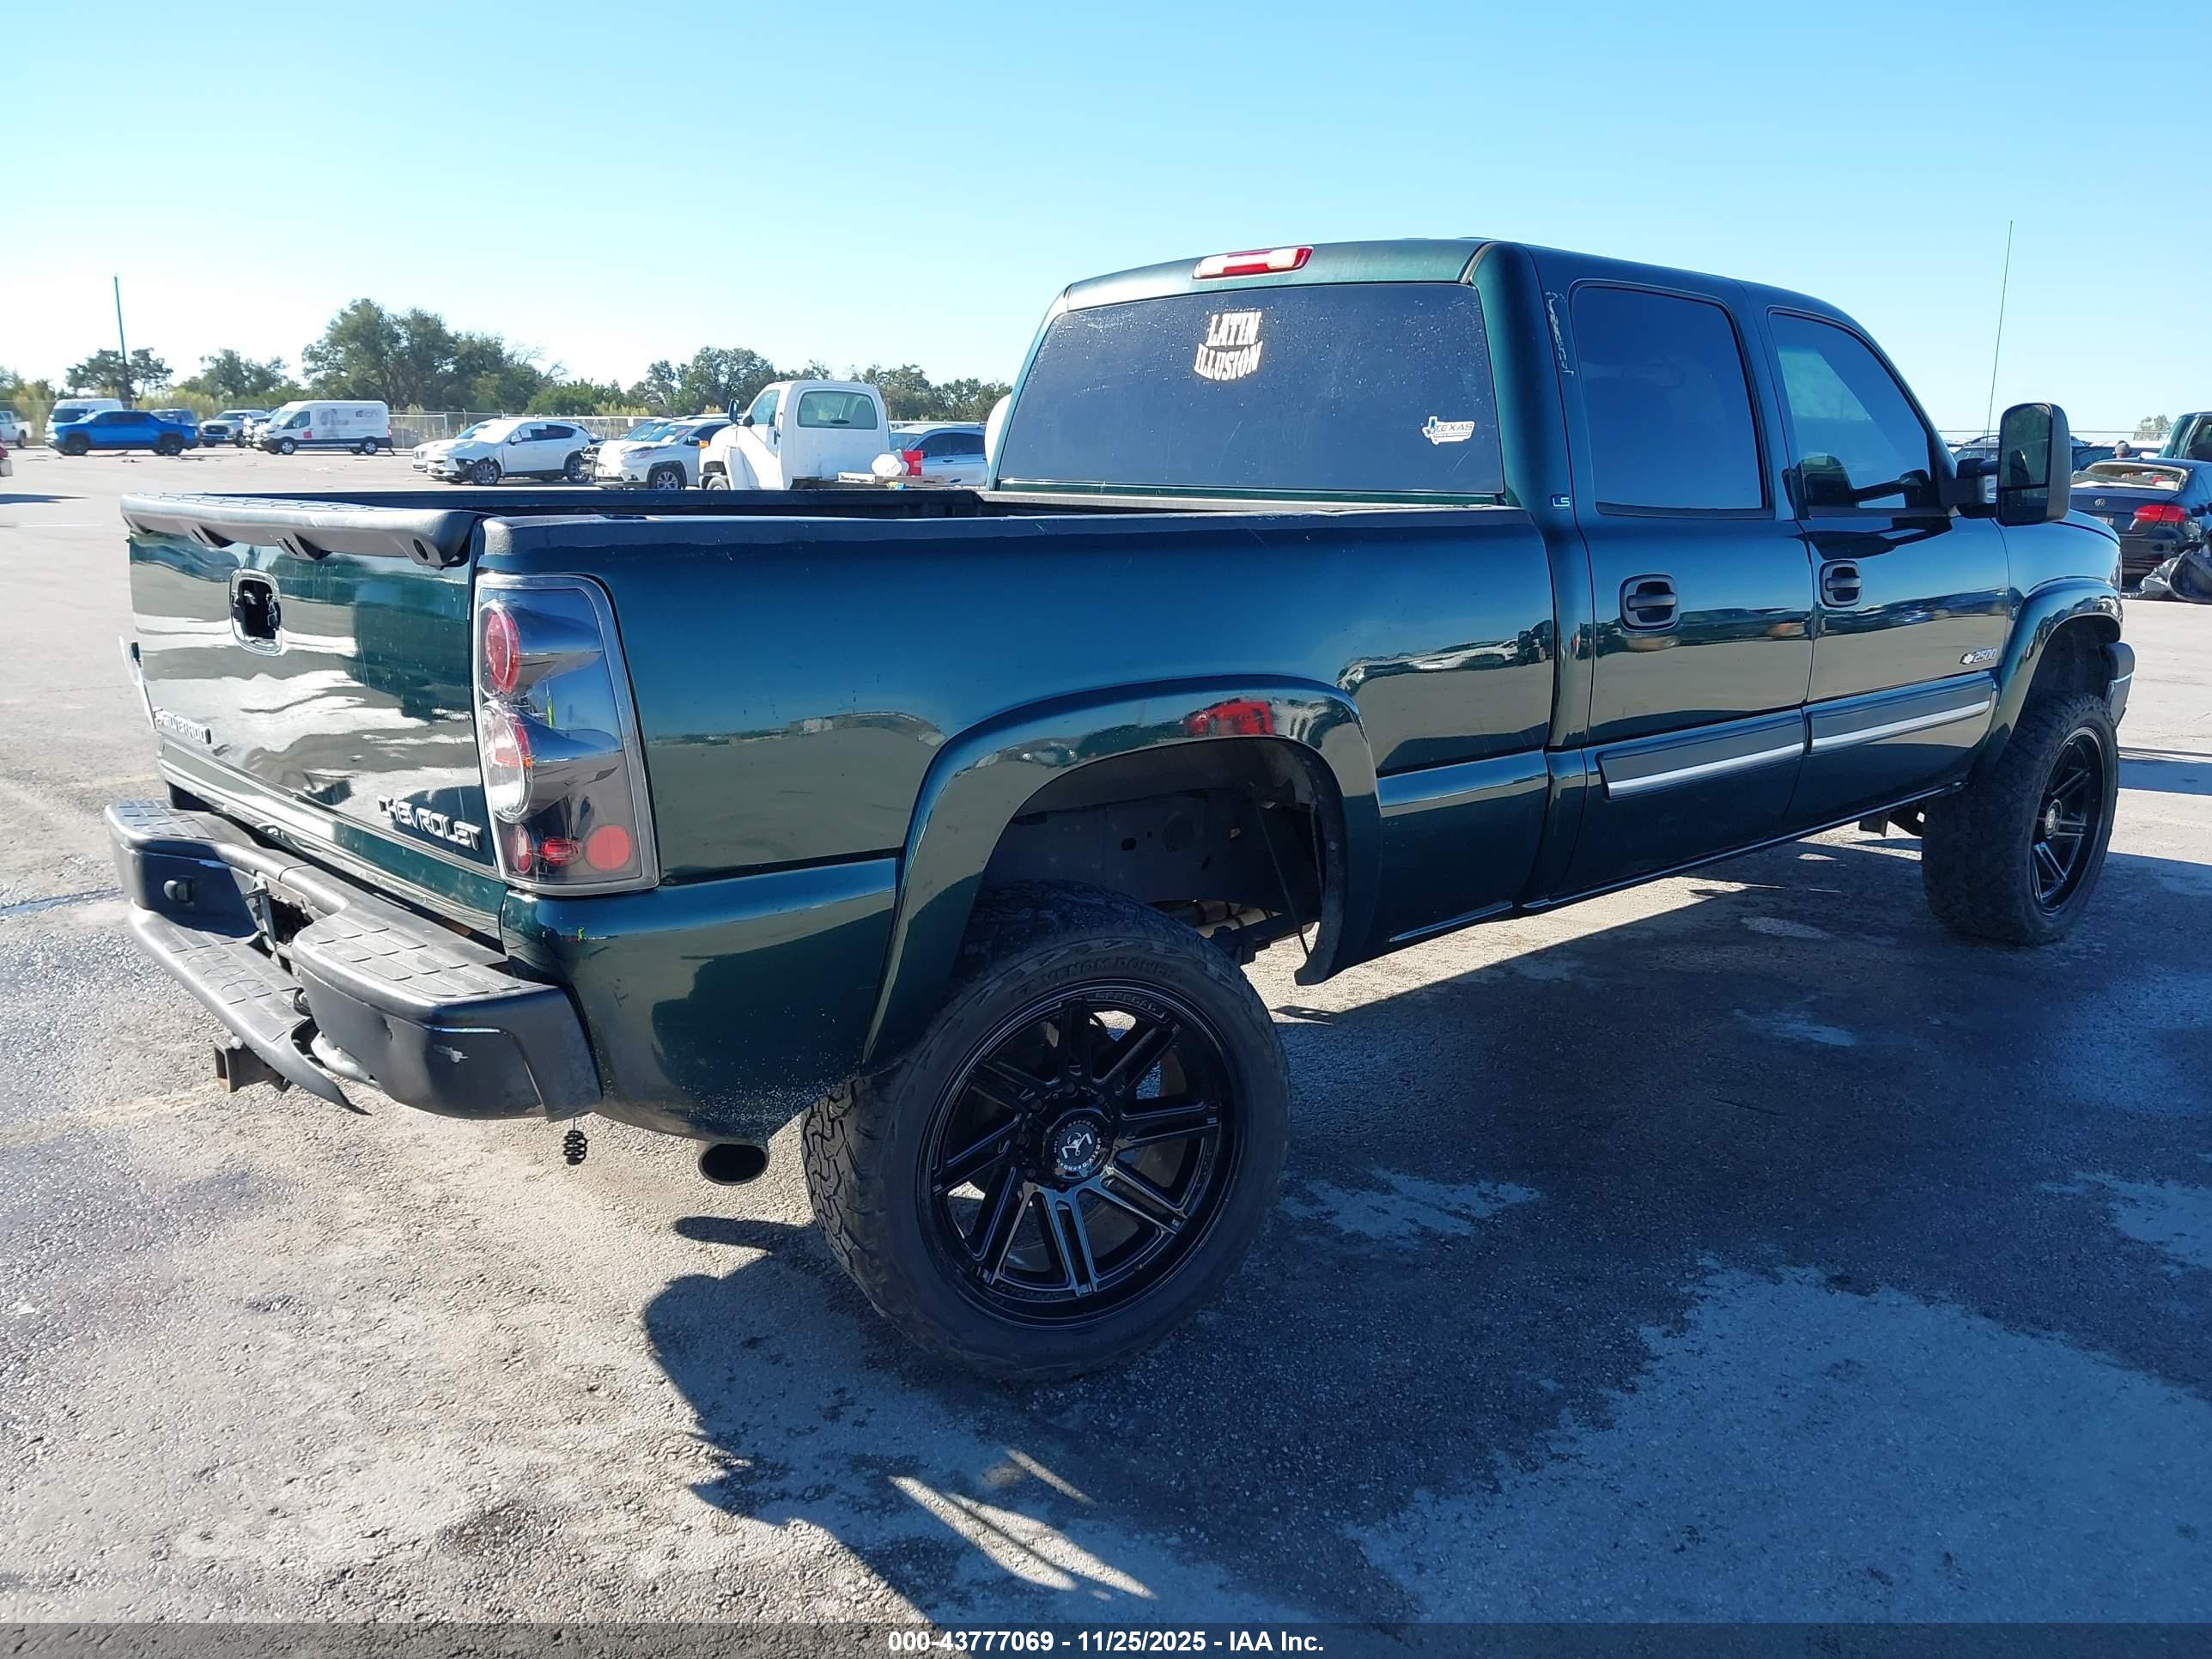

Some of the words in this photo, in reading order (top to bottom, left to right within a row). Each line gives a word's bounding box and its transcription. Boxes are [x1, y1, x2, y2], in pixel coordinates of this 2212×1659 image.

[1205, 311, 1262, 347] LATIN
[1194, 340, 1263, 381] ILLUSION
[1435, 422, 1474, 432] TEXAS
[1552, 496, 1571, 507] LS
[377, 794, 482, 852] CHEVROLET
